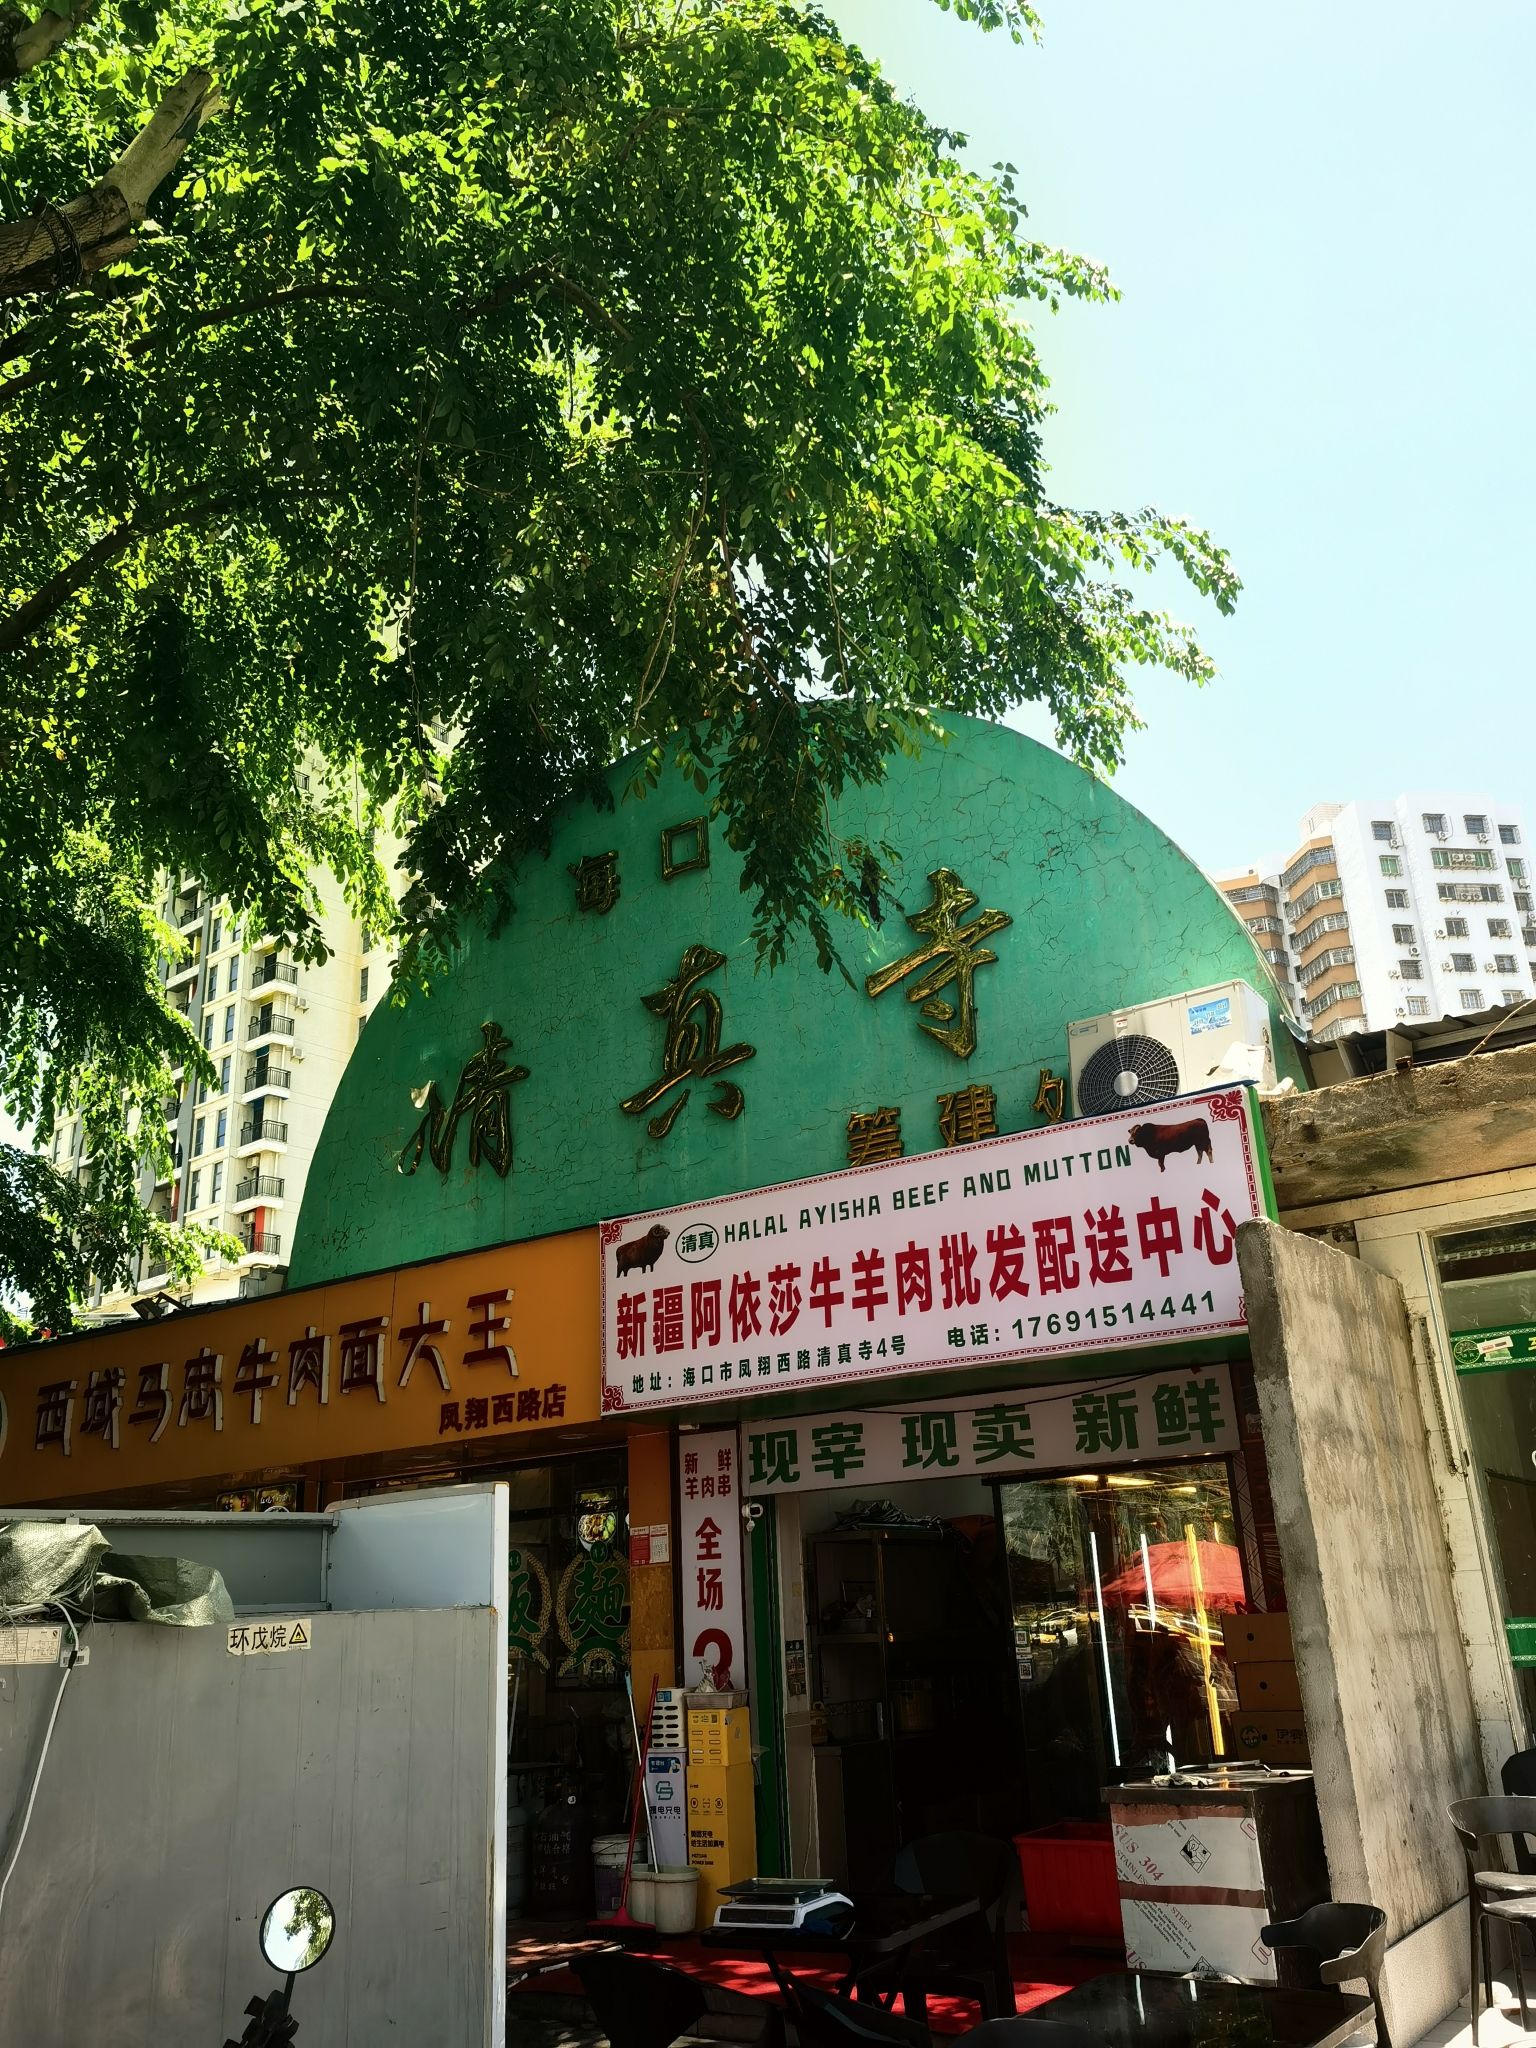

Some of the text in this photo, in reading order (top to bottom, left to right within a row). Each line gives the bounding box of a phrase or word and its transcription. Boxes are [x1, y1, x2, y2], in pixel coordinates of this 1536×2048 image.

[724, 1145, 1132, 1243] HALAL AYISHA BEEF AND MUTTON
[681, 1230, 715, 1254] 清真
[616, 1188, 1237, 1360] 新疆阿依莎牛羊肉批发配送中心
[438, 1383, 567, 1434] 凤翔西路店
[748, 1378, 1226, 1485] 现宰 现卖 新鲜
[684, 1448, 732, 1475] 新鲜
[684, 1474, 732, 1500] 羊肉串
[696, 1517, 724, 1611] 全场
[229, 1625, 287, 1651] 环戊烷
[1138, 1856, 1164, 1881] 304
[1172, 1906, 1193, 1933] STEEL
